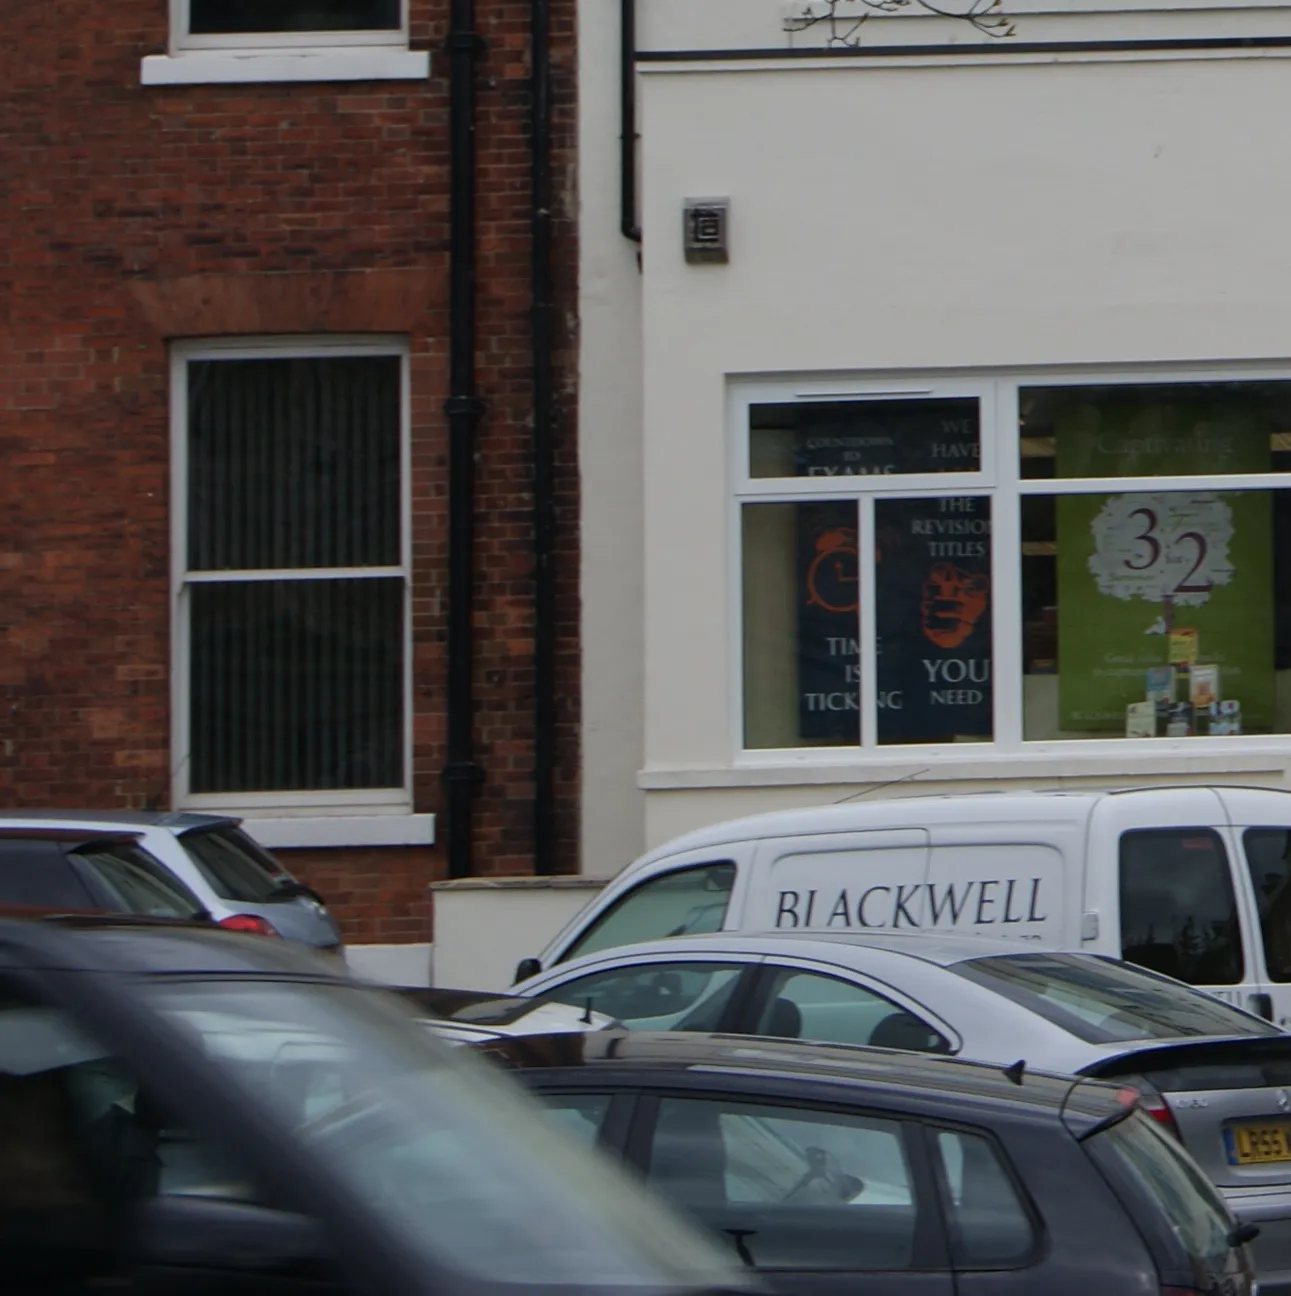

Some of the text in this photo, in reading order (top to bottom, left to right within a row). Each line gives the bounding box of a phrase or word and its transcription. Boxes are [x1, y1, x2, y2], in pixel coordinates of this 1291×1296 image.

[940, 418, 973, 434] WE
[931, 442, 981, 458] HAVE
[939, 496, 975, 513] THE
[929, 540, 984, 557] TITLES
[1124, 507, 1163, 571] 3
[1172, 531, 1214, 593] 2
[921, 658, 990, 683] YOU
[805, 690, 904, 711] TICKNG
[930, 689, 983, 705] NEED
[774, 878, 1047, 929] BLACKWELL
